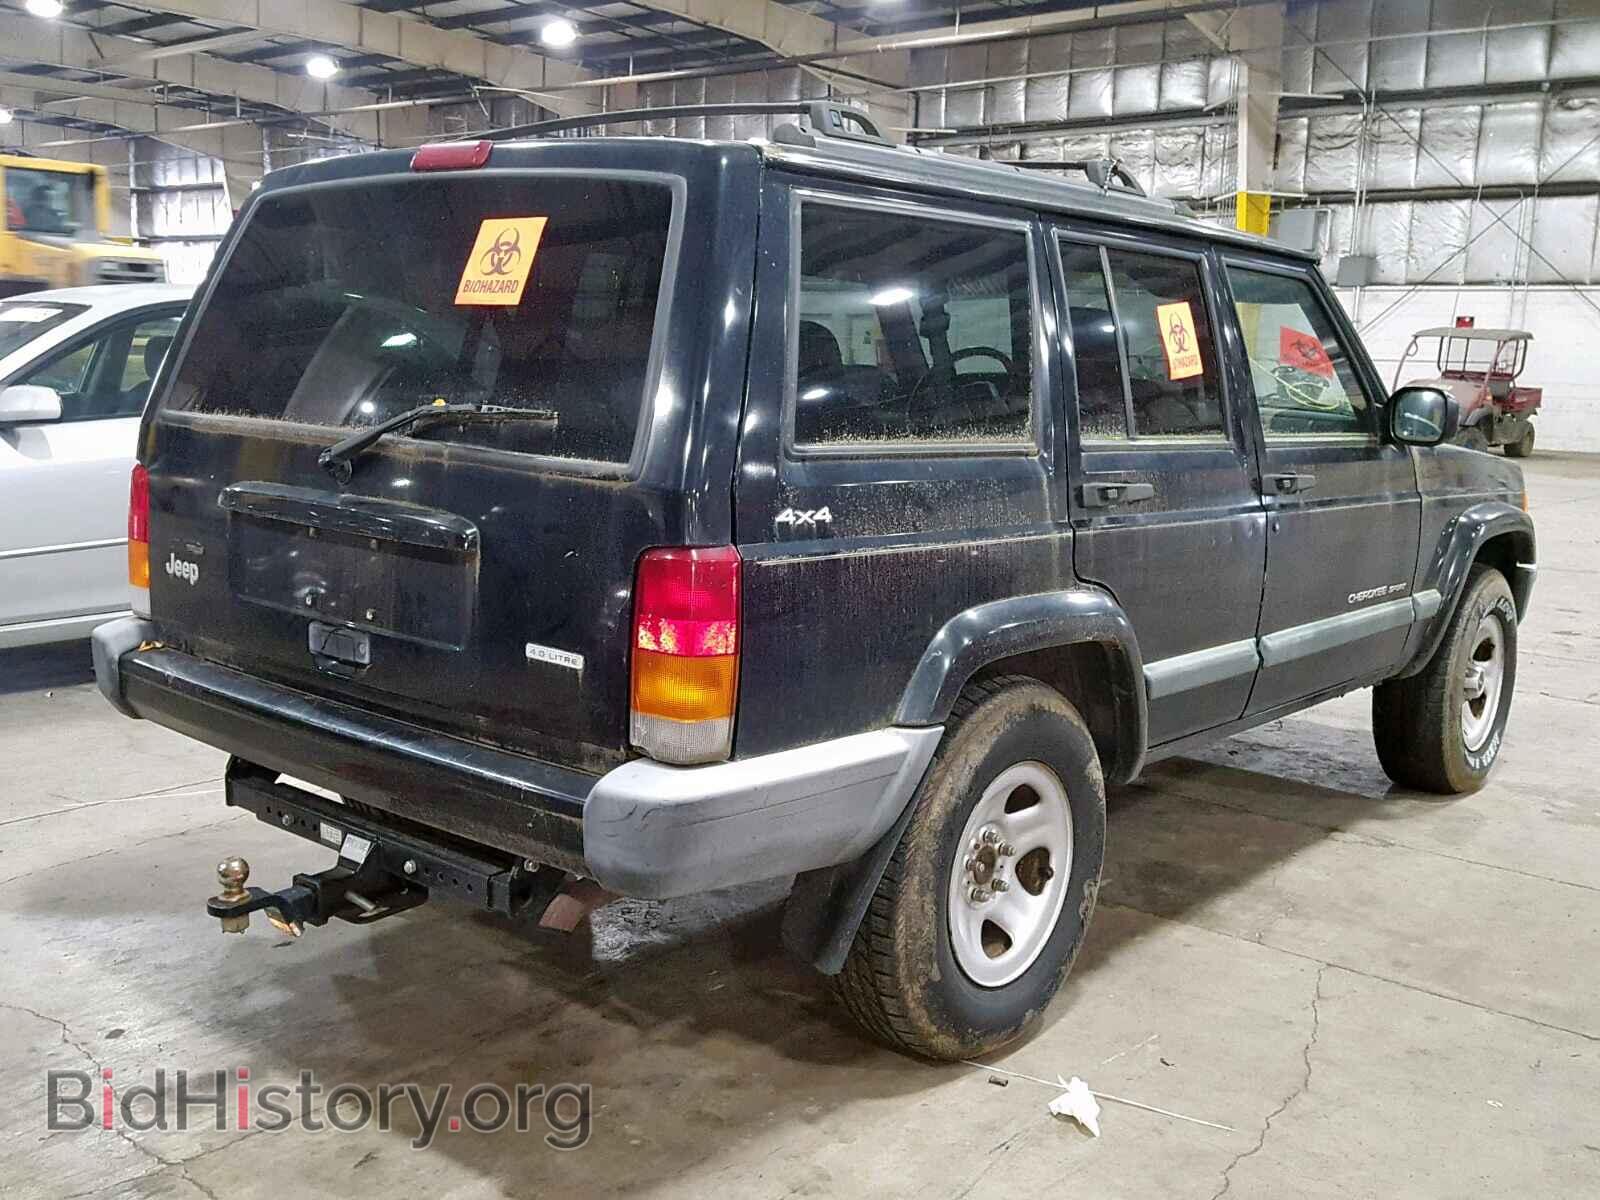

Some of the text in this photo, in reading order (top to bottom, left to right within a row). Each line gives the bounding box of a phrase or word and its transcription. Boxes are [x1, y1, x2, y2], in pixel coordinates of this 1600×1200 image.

[463, 279, 519, 293] BIOHAZARD
[165, 552, 199, 586] Jeep
[548, 652, 577, 665] LITRE
